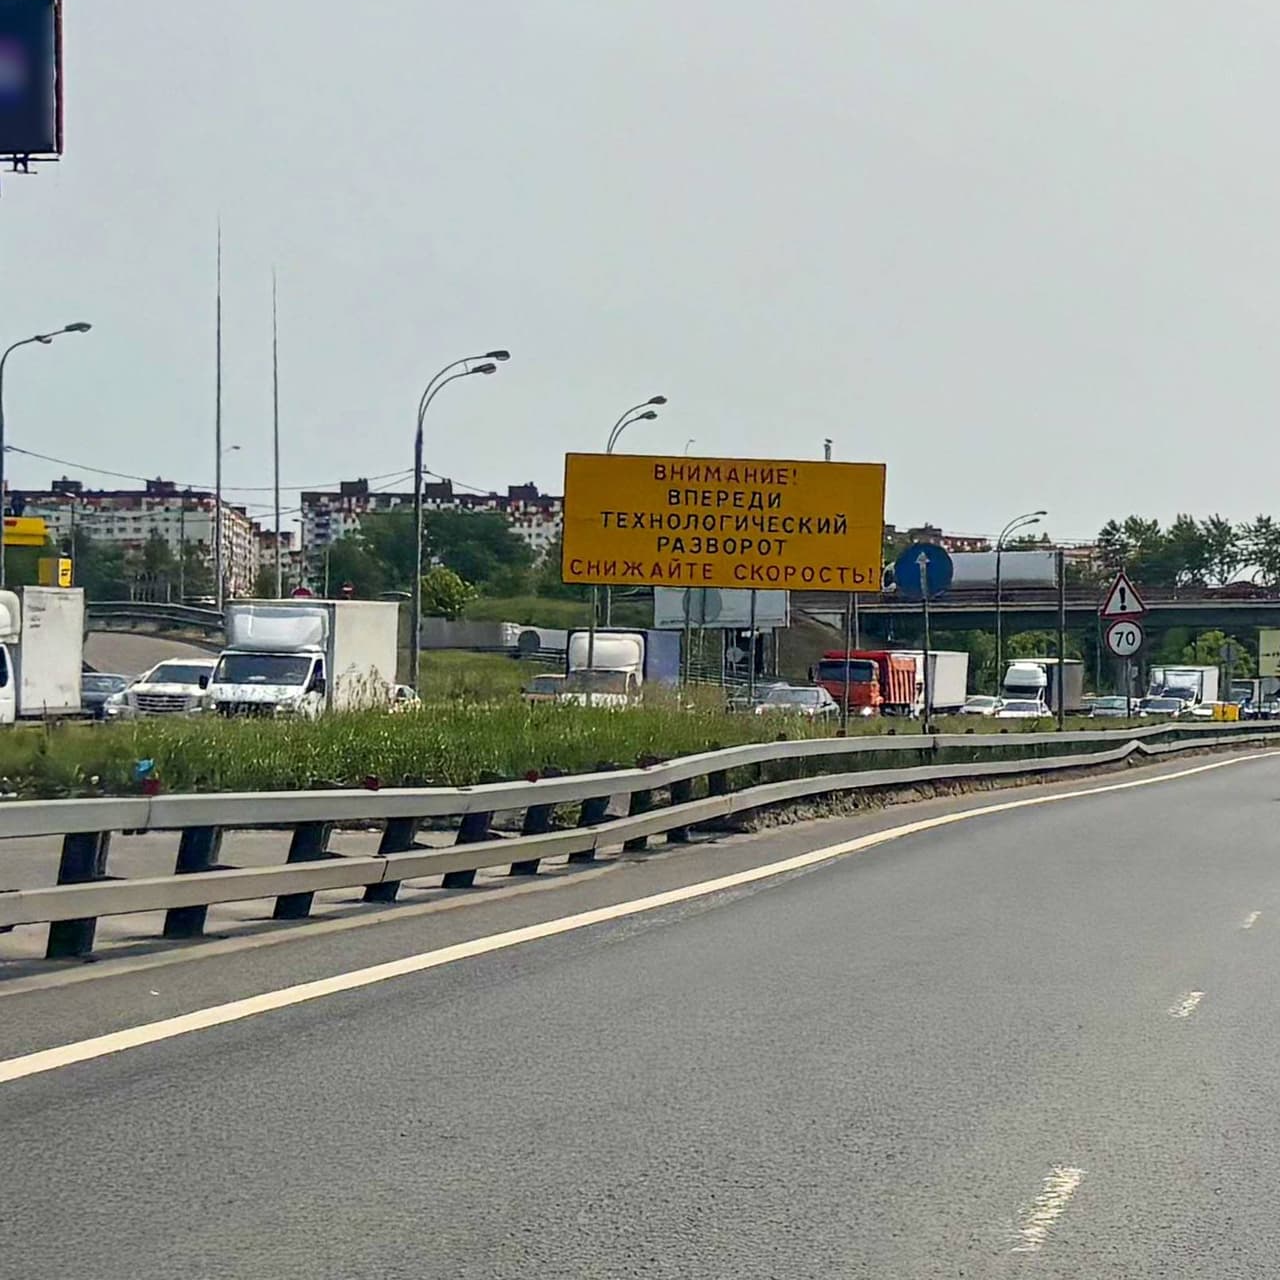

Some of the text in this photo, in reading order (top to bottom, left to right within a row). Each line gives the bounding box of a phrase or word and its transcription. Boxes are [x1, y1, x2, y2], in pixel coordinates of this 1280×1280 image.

[653, 463, 799, 486] ВНИМАНИЕ!
[667, 489, 782, 511] ВПЕРЕДИ
[600, 510, 848, 536] ТЕХНОЛОГИЧЕСКИЙ
[656, 536, 788, 556] РАЗВОРОТ
[569, 557, 874, 586] СНИЖАЙТЕ СКОРОСТЬ!
[1114, 630, 1136, 648] 70
